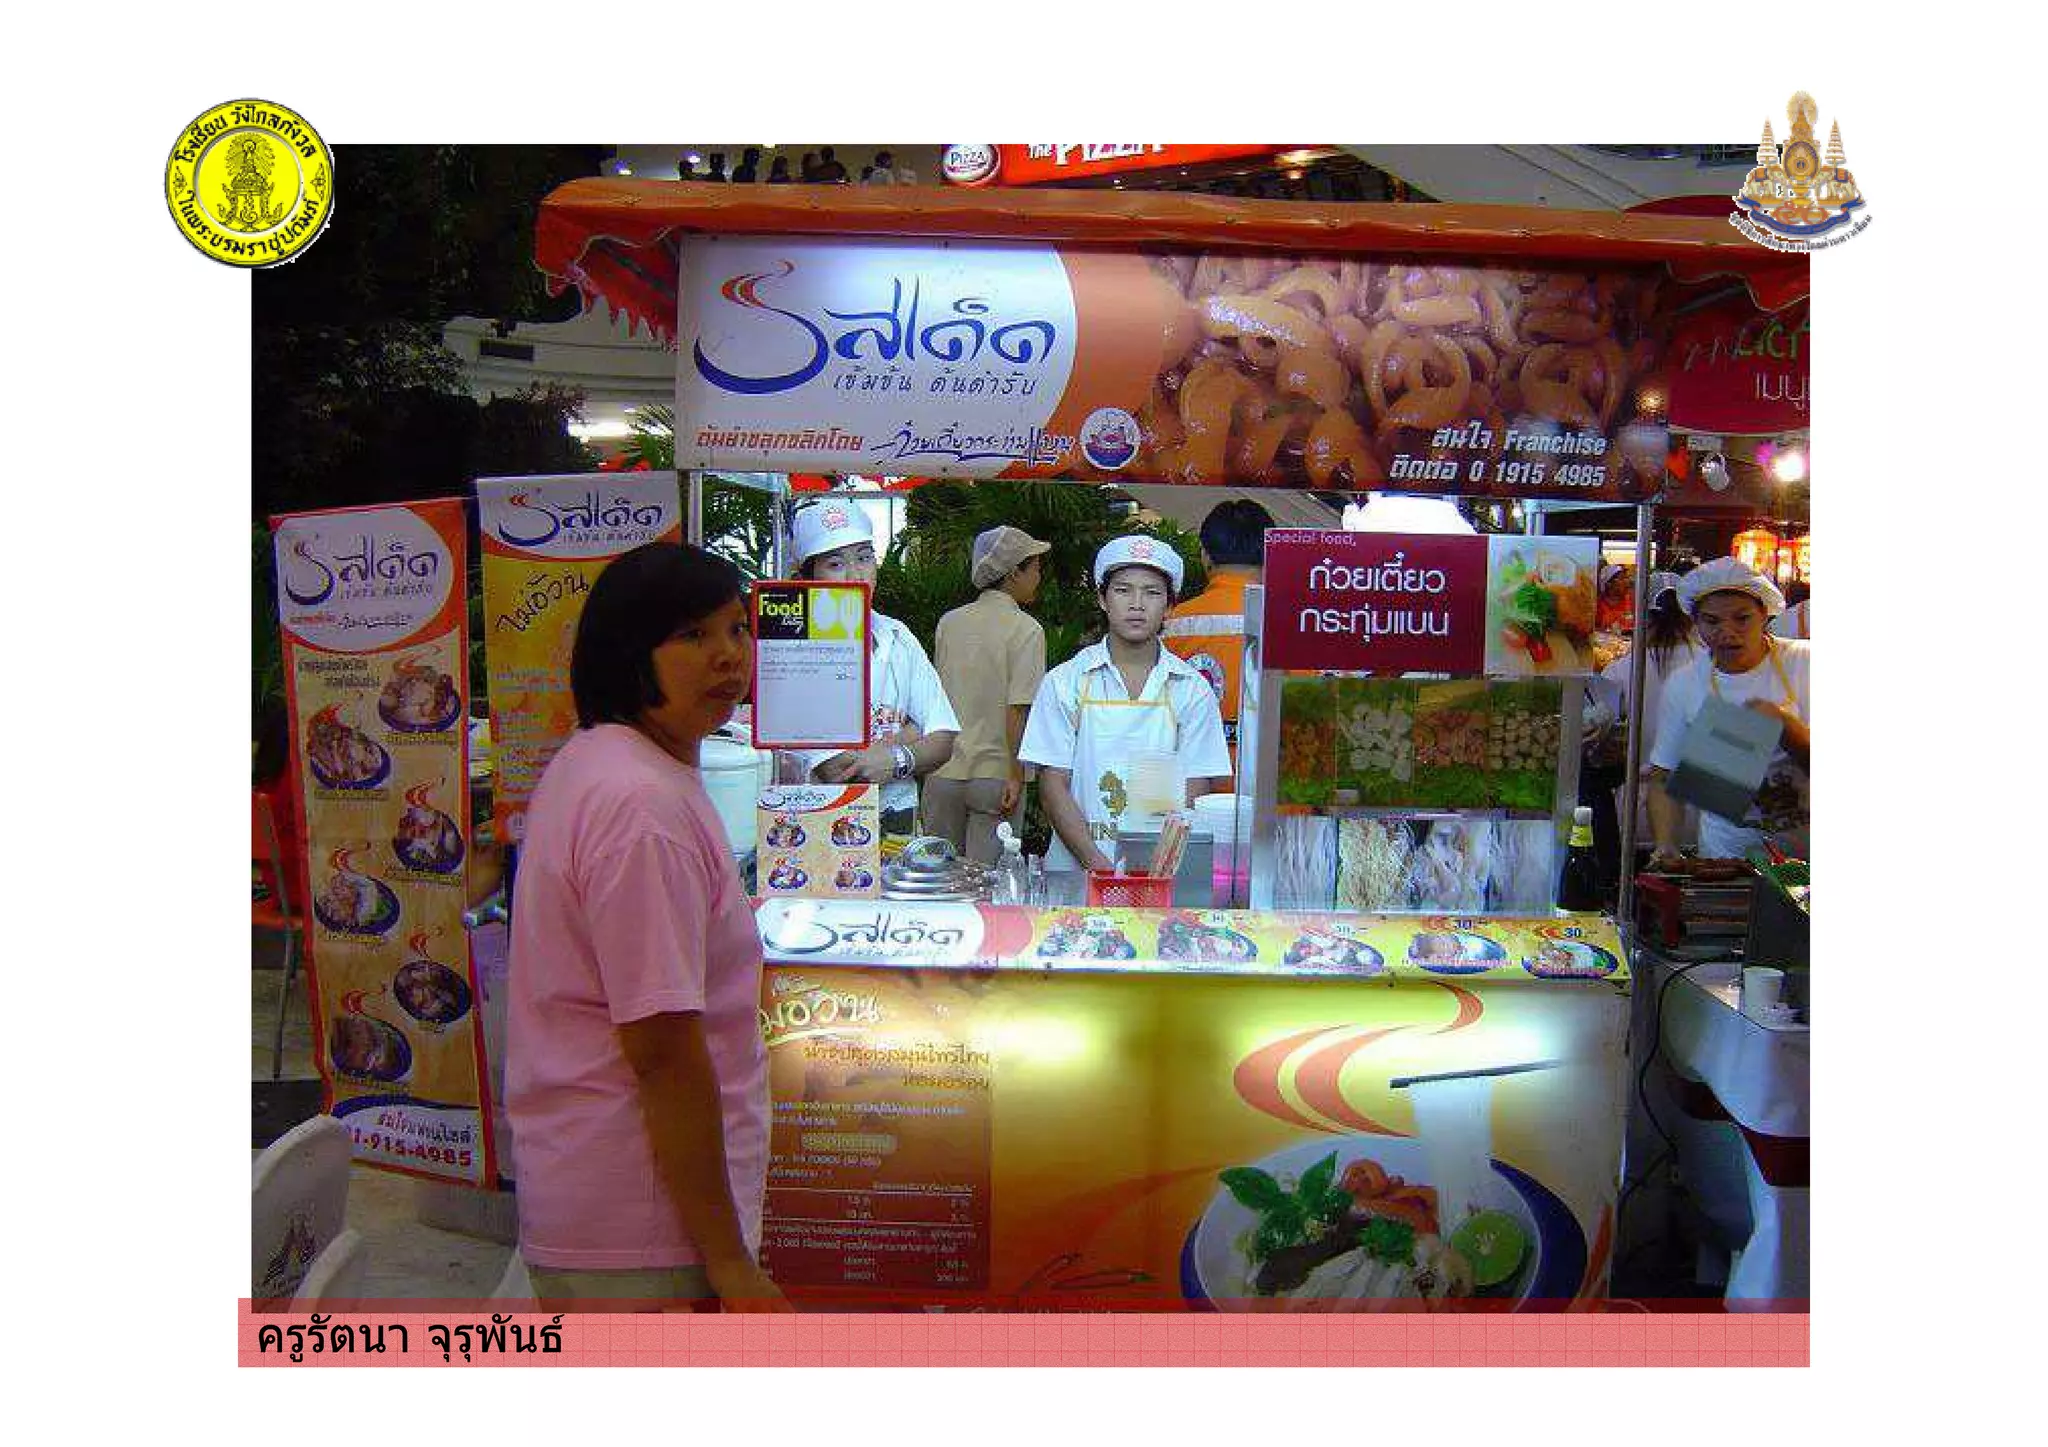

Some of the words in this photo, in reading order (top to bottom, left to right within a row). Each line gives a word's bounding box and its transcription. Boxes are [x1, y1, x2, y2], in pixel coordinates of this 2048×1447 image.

[694, 259, 1056, 395] รสเด็ด
[1431, 420, 1492, 449] สนใจ
[1503, 430, 1607, 455] Franchise
[1389, 454, 1458, 480] ติดต่อ
[1469, 461, 1485, 482] 0
[1496, 461, 1545, 484] 1915
[1553, 464, 1606, 486] 4985
[1309, 551, 1446, 593] ก๋วยเตี๋ยว
[758, 593, 804, 616] Food
[1300, 603, 1449, 642] กระทุ่มแบน
[348, 1126, 473, 1166] 1-915-4985
